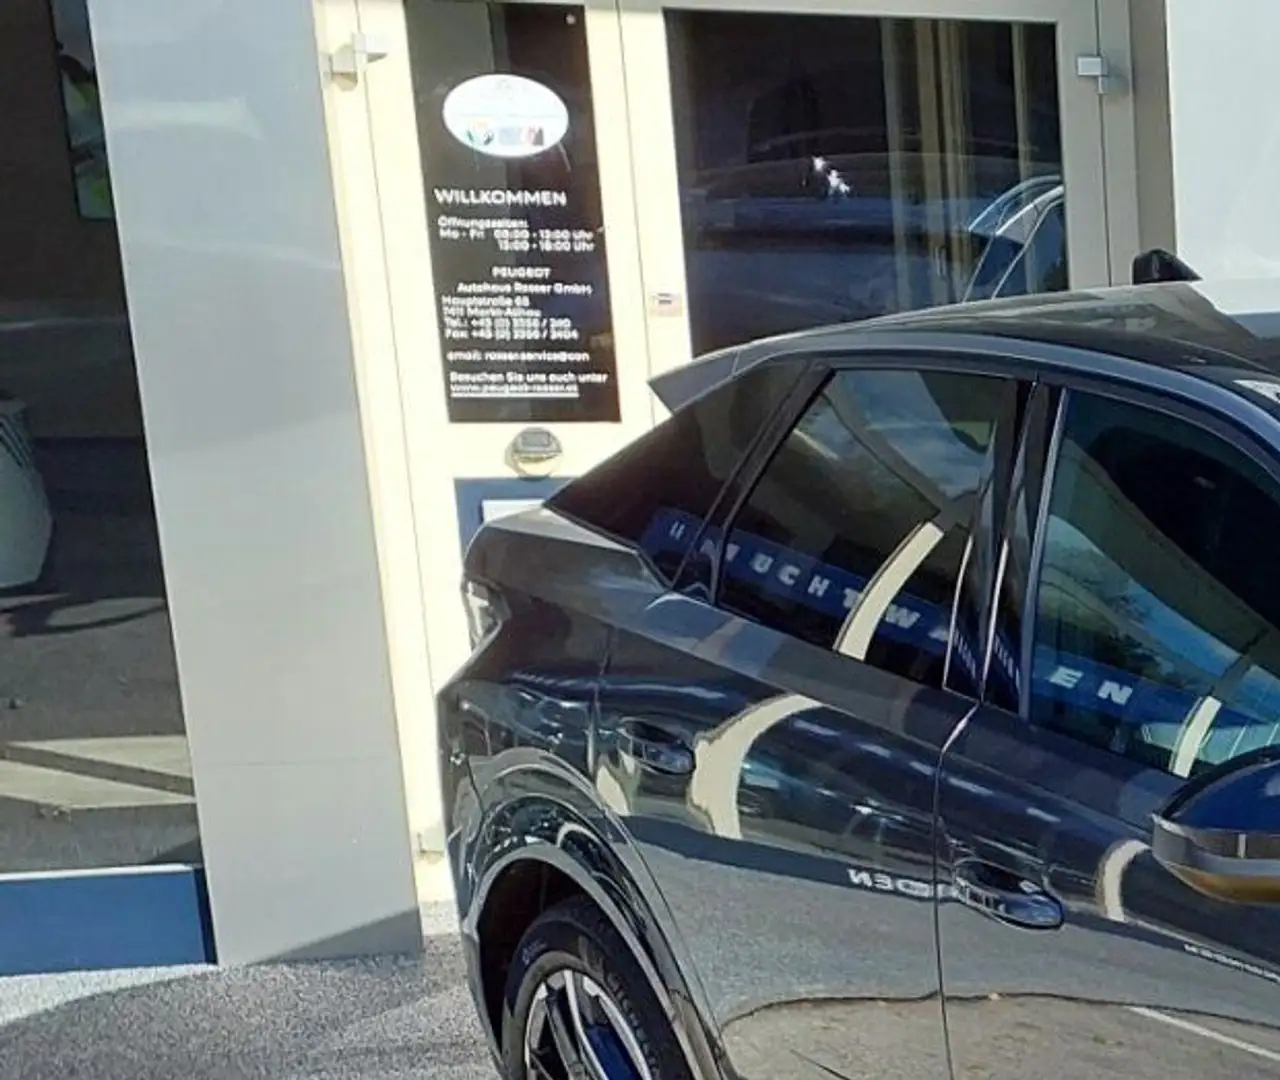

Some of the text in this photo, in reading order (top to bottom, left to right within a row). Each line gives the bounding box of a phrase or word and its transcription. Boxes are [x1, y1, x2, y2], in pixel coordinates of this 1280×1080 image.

[433, 188, 568, 206] WILLKOMMEN
[491, 266, 551, 278] PEUGEOT
[456, 282, 512, 293] Autohaus
